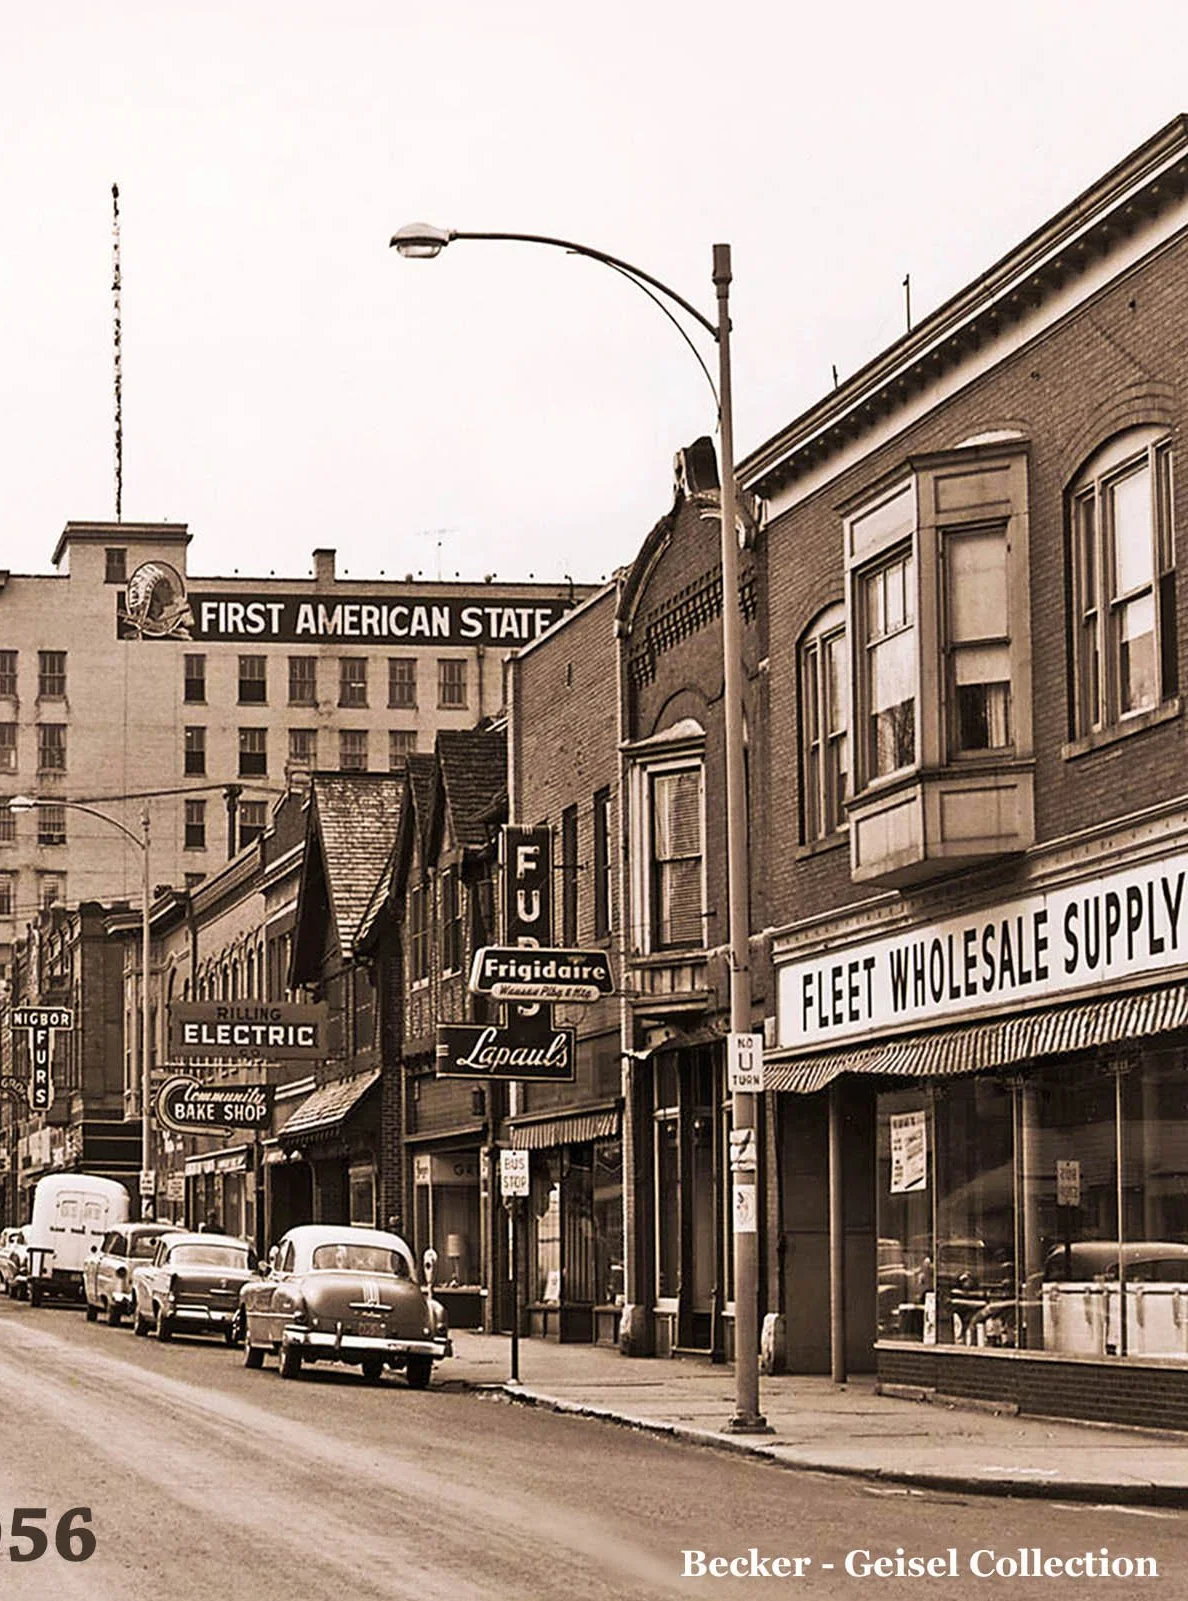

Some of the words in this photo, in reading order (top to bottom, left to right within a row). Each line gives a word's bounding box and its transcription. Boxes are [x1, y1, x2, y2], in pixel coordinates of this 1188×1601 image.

[200, 600, 285, 634] FIRST
[296, 603, 451, 638] AMERICAN
[460, 606, 552, 640] STATE
[802, 956, 876, 1033] FLEET
[889, 909, 1049, 1013] WHOLESALE
[1064, 871, 1187, 975] SUPPLY
[484, 958, 606, 982] Frigidaire
[13, 1011, 69, 1026] NIGBOR
[216, 1007, 282, 1022] RILLING
[184, 1023, 314, 1046] ELECTRIC
[737, 1037, 753, 1049] NO
[36, 1029, 47, 1104] FURS
[738, 1052, 754, 1072] U
[732, 1075, 760, 1086] TURN
[183, 1081, 266, 1105] Community
[174, 1103, 215, 1121] BAKE
[224, 1103, 268, 1121] SHOP
[504, 1158, 526, 1170] BUS
[503, 1176, 527, 1189] STOP
